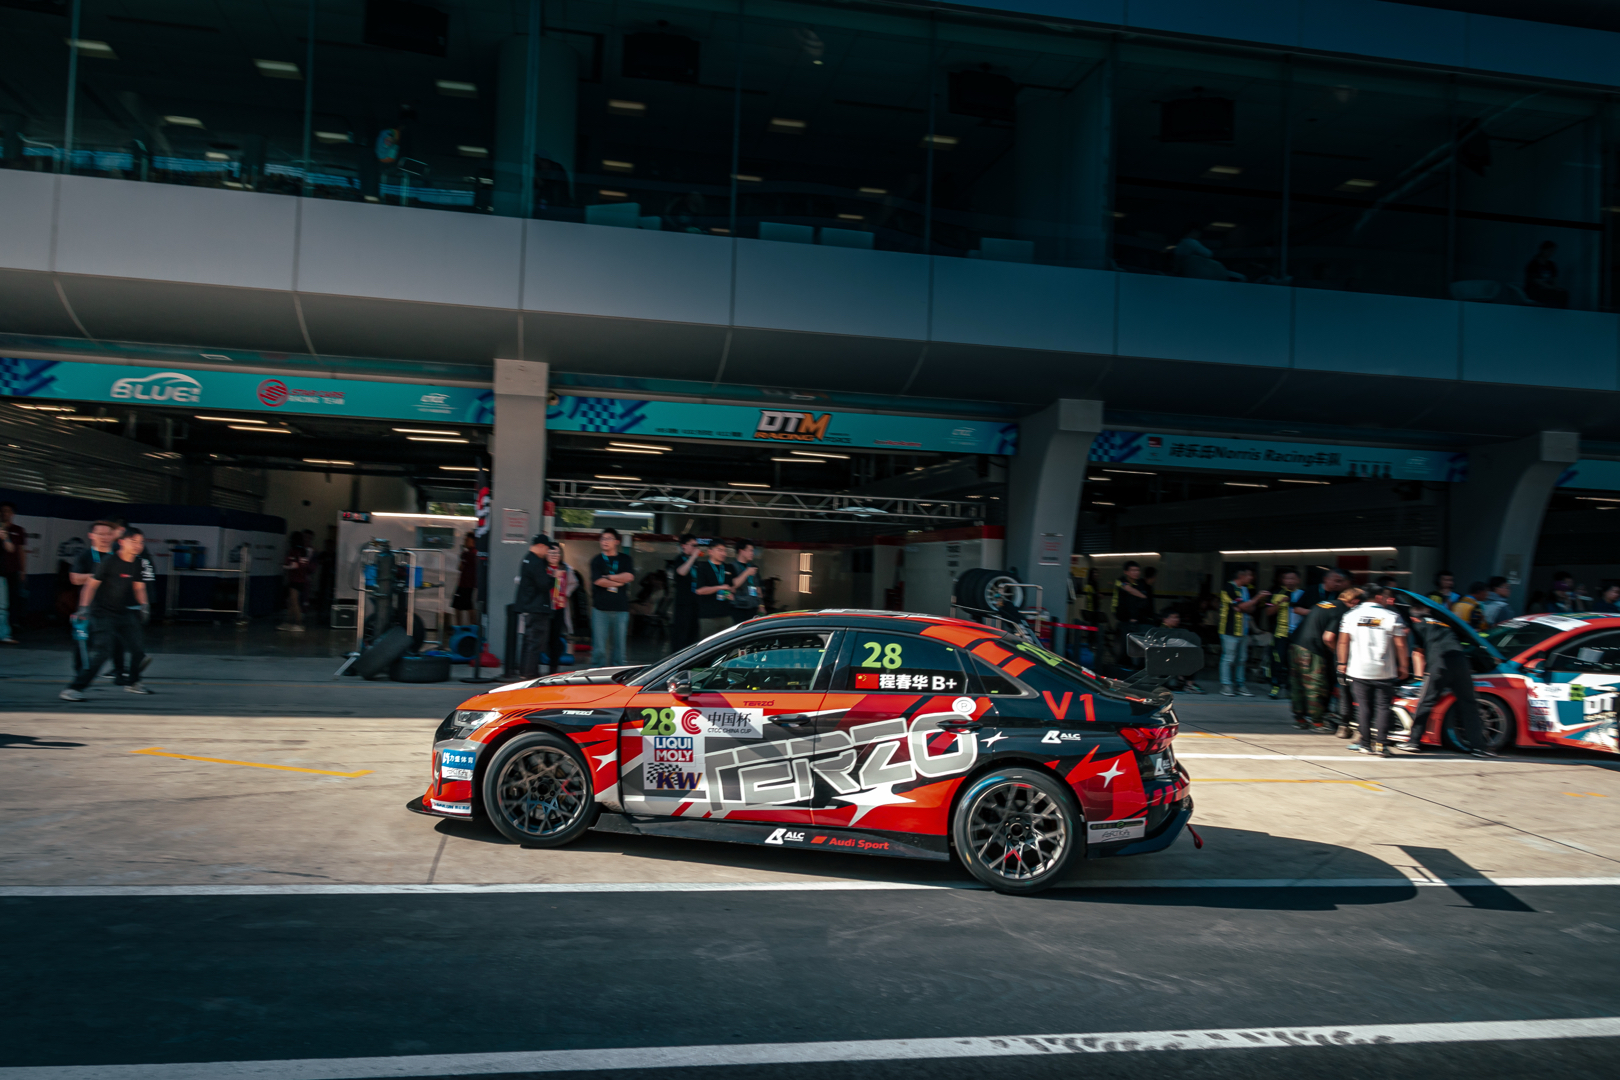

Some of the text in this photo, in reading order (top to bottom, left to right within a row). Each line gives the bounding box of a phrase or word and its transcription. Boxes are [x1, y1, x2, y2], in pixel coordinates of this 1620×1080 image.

[757, 409, 831, 441] DTM
[861, 641, 903, 670] 28
[879, 673, 958, 691] 程春华 B+
[640, 707, 677, 736] 28
[707, 711, 752, 727] 中国杯
[656, 737, 692, 750] LIQUI
[449, 755, 474, 764] 力盛体育
[656, 750, 692, 763] MOLY
[704, 711, 979, 813] TERZO
[655, 771, 703, 790] KW
[784, 831, 806, 839] ALC
[828, 837, 890, 850] Audi Sport
